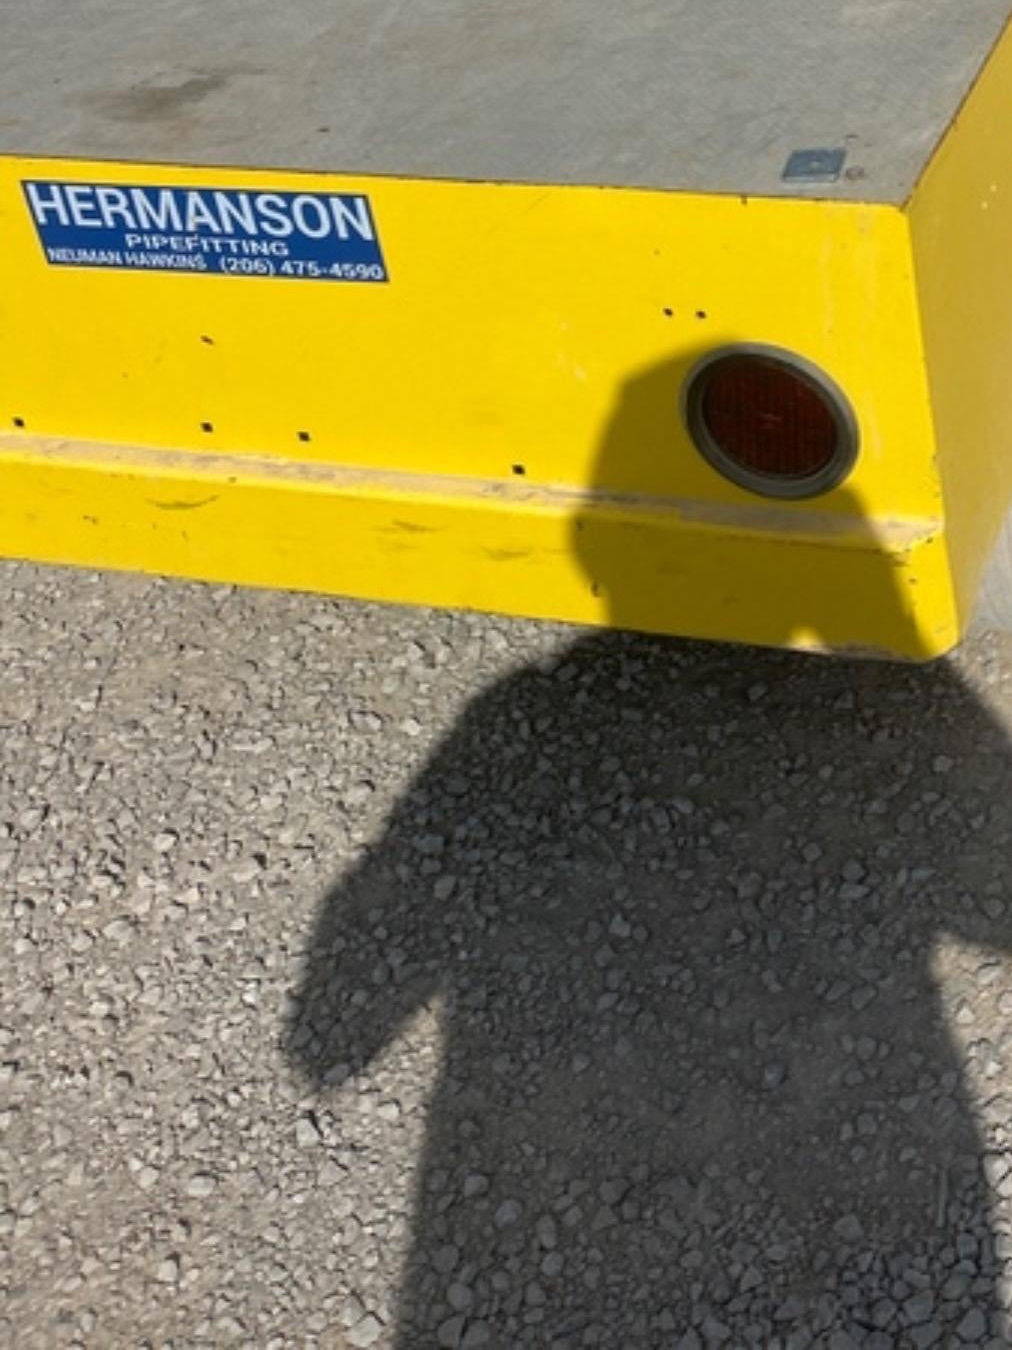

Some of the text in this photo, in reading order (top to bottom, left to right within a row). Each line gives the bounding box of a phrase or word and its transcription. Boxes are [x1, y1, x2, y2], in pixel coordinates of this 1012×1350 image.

[25, 181, 375, 241] HERMANSON
[124, 232, 290, 257] PIPEFITTING
[219, 256, 276, 277] (206)
[280, 259, 385, 281] 475-4590
